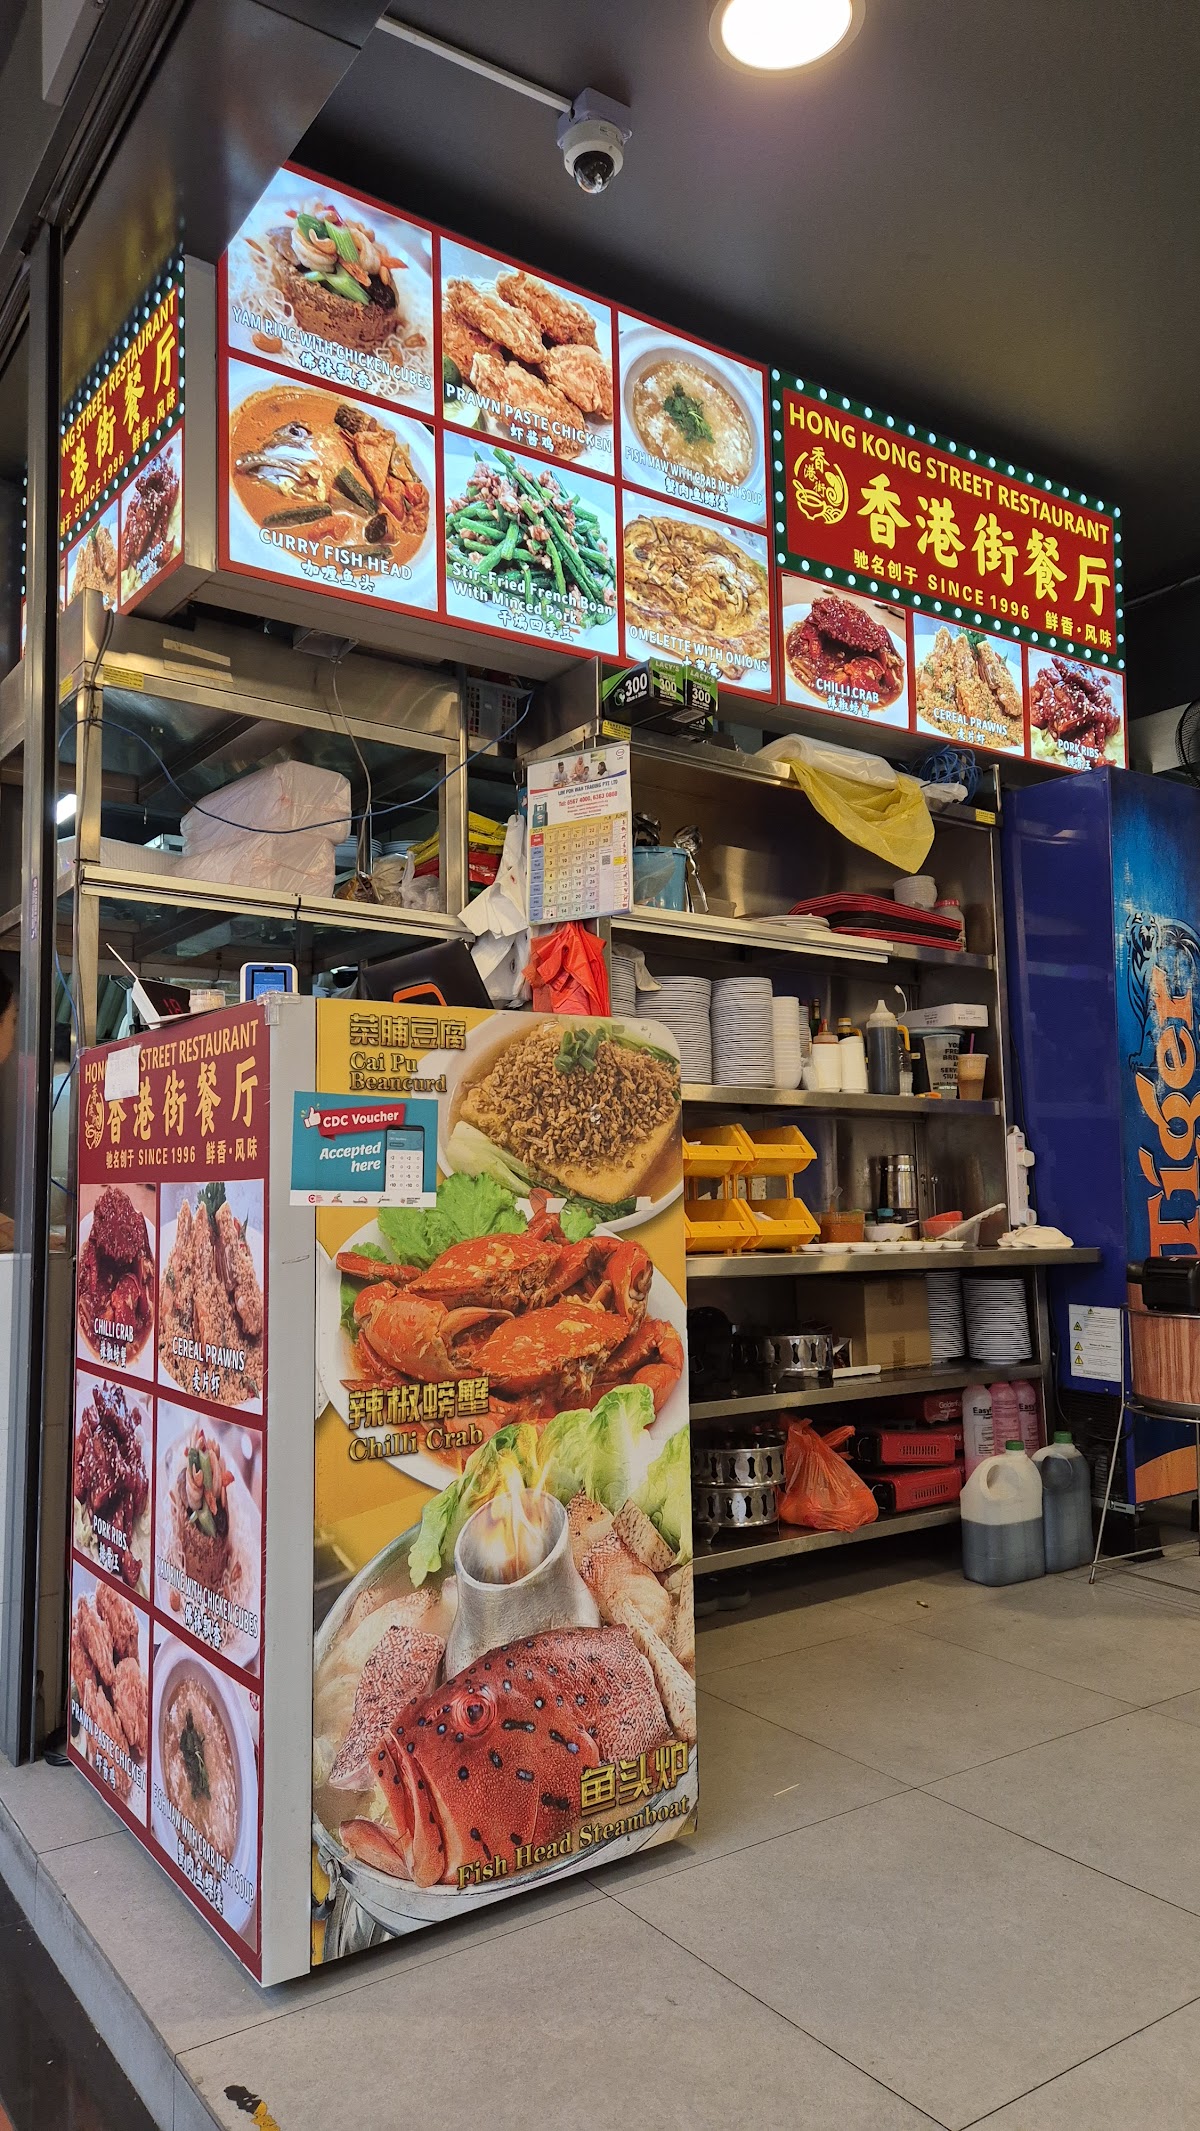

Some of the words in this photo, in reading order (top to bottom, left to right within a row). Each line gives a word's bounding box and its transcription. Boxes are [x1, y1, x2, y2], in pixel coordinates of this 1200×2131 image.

[76, 381, 107, 439] STREET
[109, 289, 176, 396] RESTAURANT
[232, 306, 261, 331] YAM
[264, 320, 298, 343] RING
[299, 330, 338, 357] WITH
[336, 343, 391, 377] CHICKEN
[392, 364, 431, 391] CUBES
[61, 322, 176, 499] 港街餐厅
[445, 382, 500, 414] PRAWN
[505, 404, 548, 430] PASTE
[552, 421, 612, 453] CHICKEN
[74, 478, 101, 518] SINCE
[102, 450, 124, 485] 1996
[625, 446, 647, 465] FISH
[648, 454, 669, 475] MAW
[670, 463, 692, 483] WITH
[694, 471, 716, 490] CRAB
[718, 480, 740, 498] MEAT
[741, 488, 763, 506] SOUP
[789, 402, 856, 449] HONG
[862, 431, 921, 474] KONG
[926, 457, 994, 501] STREET
[998, 484, 1110, 545] RESTAURANT
[259, 528, 319, 556] CURRY
[324, 545, 363, 568] FISH
[367, 556, 412, 580] HEAD
[857, 473, 1111, 617] 香港街餐厅
[452, 561, 525, 594] Stir-Fried
[530, 583, 581, 607] French
[453, 580, 488, 602] With
[492, 591, 542, 615] Minced
[546, 605, 577, 624] Pork
[853, 548, 918, 585] 驰名创于
[928, 574, 984, 606] SINCE
[990, 595, 1029, 620] 1996
[629, 625, 691, 653] OMELETTE
[693, 640, 723, 661] WITH
[726, 651, 768, 672] ONIONS
[655, 660, 680, 673] LACY'S
[625, 673, 648, 697] 300
[660, 679, 677, 693] 300
[690, 669, 715, 684] LACY'S
[692, 688, 711, 704] 300
[816, 678, 851, 697] CHILLI
[852, 687, 879, 703] CRAB
[933, 707, 969, 726] CEREAL
[970, 717, 1008, 736] PRAWNS
[1057, 739, 1079, 756] PORK
[1081, 746, 1100, 759] RIBS
[85, 1060, 107, 1085] HON
[140, 1042, 177, 1073] STREET
[179, 1019, 259, 1064] RESTAURANT
[350, 1013, 466, 1050] 菜脯豆腐
[349, 1071, 447, 1093] Beancurd
[350, 1051, 386, 1072] Cai
[390, 1053, 418, 1072] Pu
[107, 1056, 259, 1144] 香港街餐厅
[323, 1115, 349, 1128] CDC
[352, 1110, 400, 1125] Voucher
[106, 1149, 134, 1170] 驰名创于
[138, 1148, 168, 1166] SINCE
[171, 1146, 196, 1164] 1996
[320, 1141, 382, 1160] Accepted
[351, 1160, 381, 1173] here
[94, 1318, 115, 1338] CHILLI
[115, 1323, 134, 1343] CRAB
[172, 1336, 204, 1362] CEREAL
[205, 1344, 245, 1372] PRAWNS
[349, 1376, 489, 1430] 辣椒螃蟹
[349, 1431, 419, 1462] Chilli
[426, 1423, 483, 1451] Crab
[93, 1514, 111, 1541] PORK
[111, 1525, 127, 1551] RIBS
[185, 1573, 203, 1606] WITH
[203, 1587, 233, 1623] CHICKEN
[234, 1605, 258, 1638] CUBES
[71, 1699, 93, 1736] PRAWN
[94, 1722, 114, 1759] PASTE
[115, 1745, 146, 1793] CHICKEN
[580, 1741, 689, 1816] 鱼头炉
[181, 1814, 198, 1851] WITH
[198, 1832, 215, 1868] CRAB
[216, 1851, 235, 1888] MEAT
[235, 1869, 254, 1908] SOUP
[457, 1852, 508, 1890] Fish
[515, 1834, 572, 1870] Head
[579, 1795, 689, 1848] Steamboat
